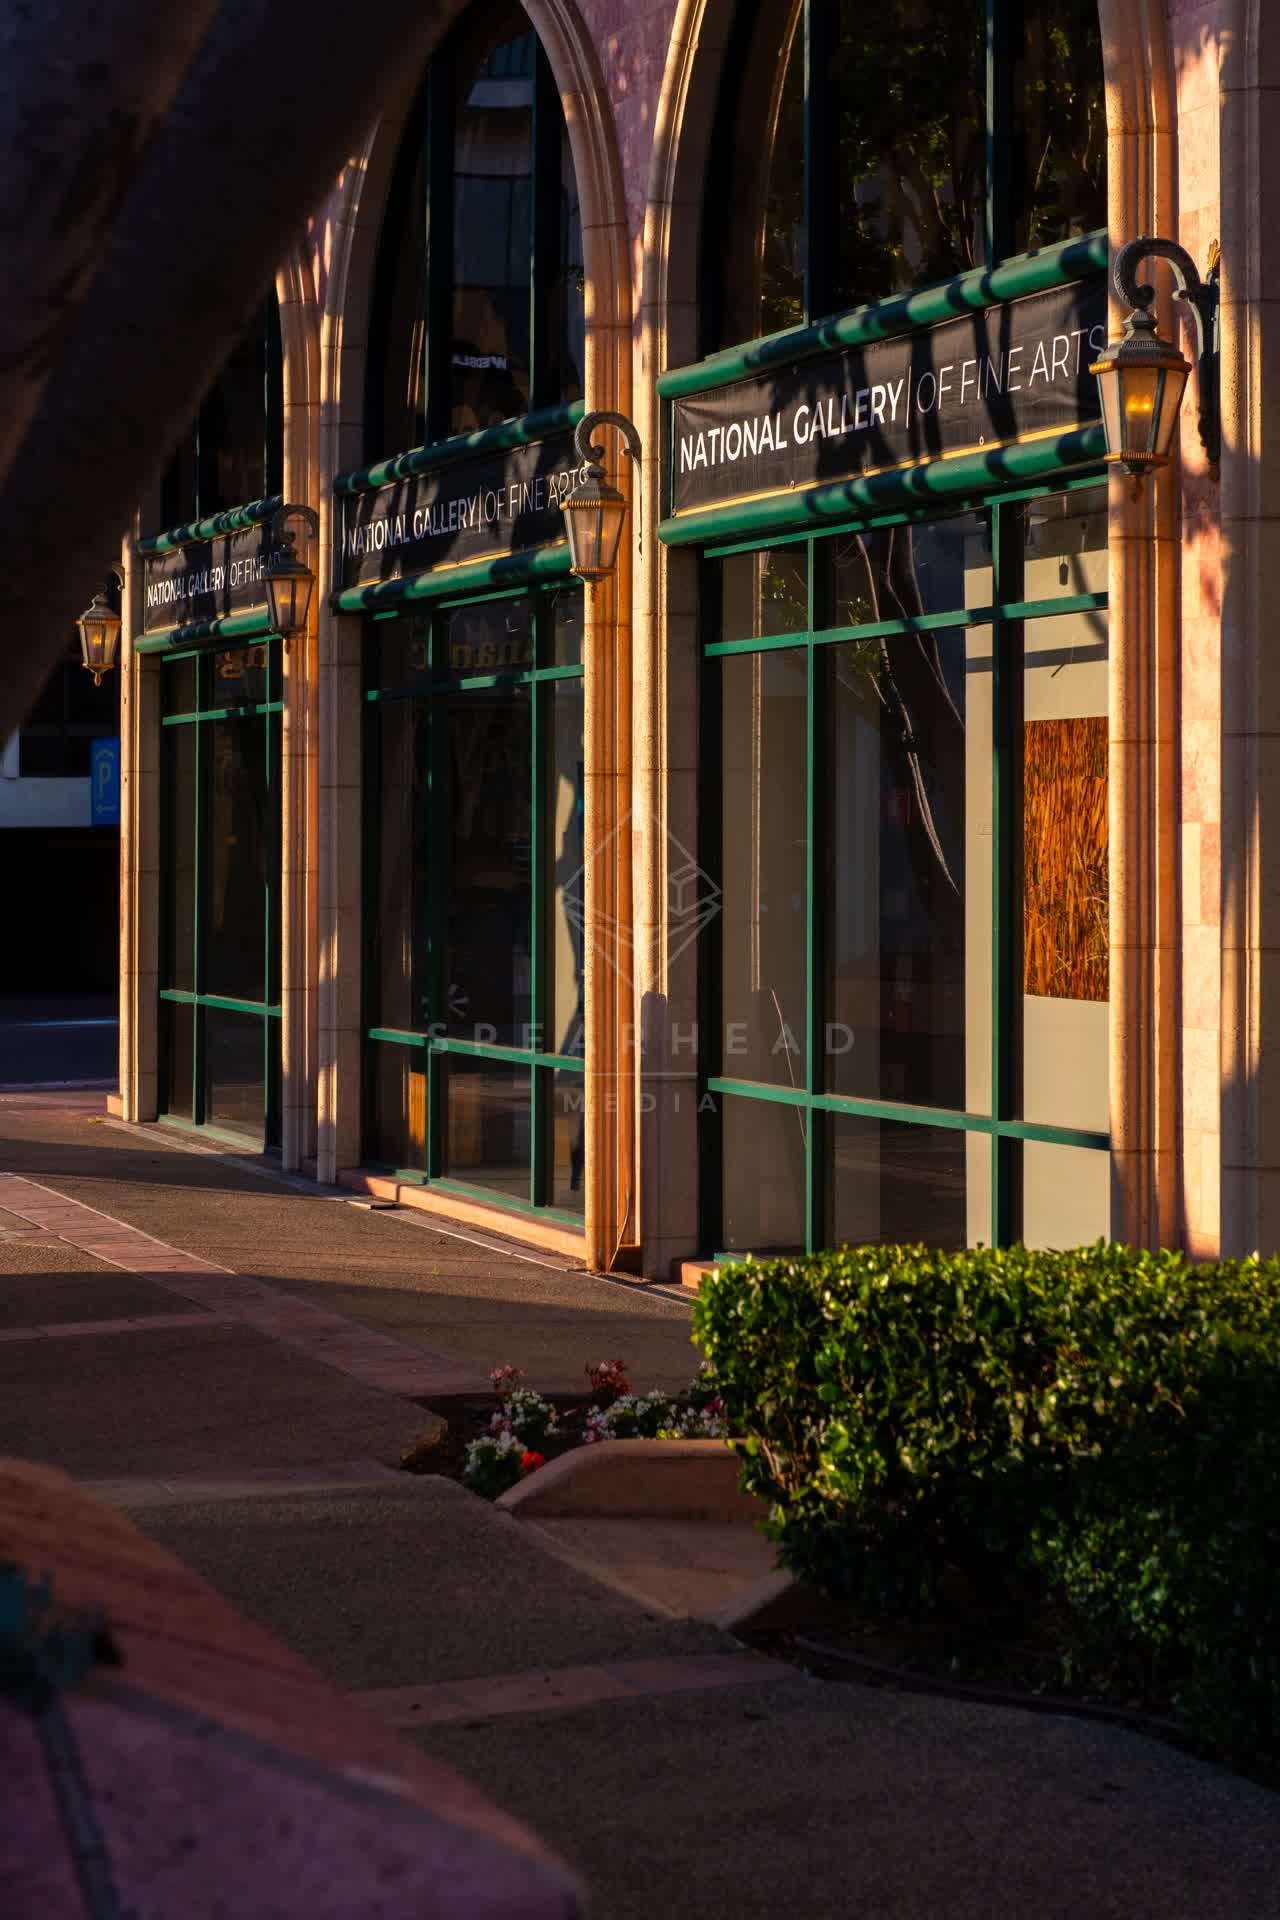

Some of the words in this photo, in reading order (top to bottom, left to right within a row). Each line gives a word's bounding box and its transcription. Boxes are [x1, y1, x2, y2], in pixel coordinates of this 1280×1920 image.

[680, 406, 787, 473] NATIONAL
[793, 378, 904, 444] GALLERY
[916, 365, 953, 414] OF
[960, 346, 1024, 404] FINE
[348, 514, 409, 557] NATIONAL
[413, 495, 476, 539] GALLERY
[484, 487, 506, 523] OF
[509, 477, 544, 517] FINE
[147, 577, 187, 607] NATIONAL
[188, 565, 227, 597] GALLERY
